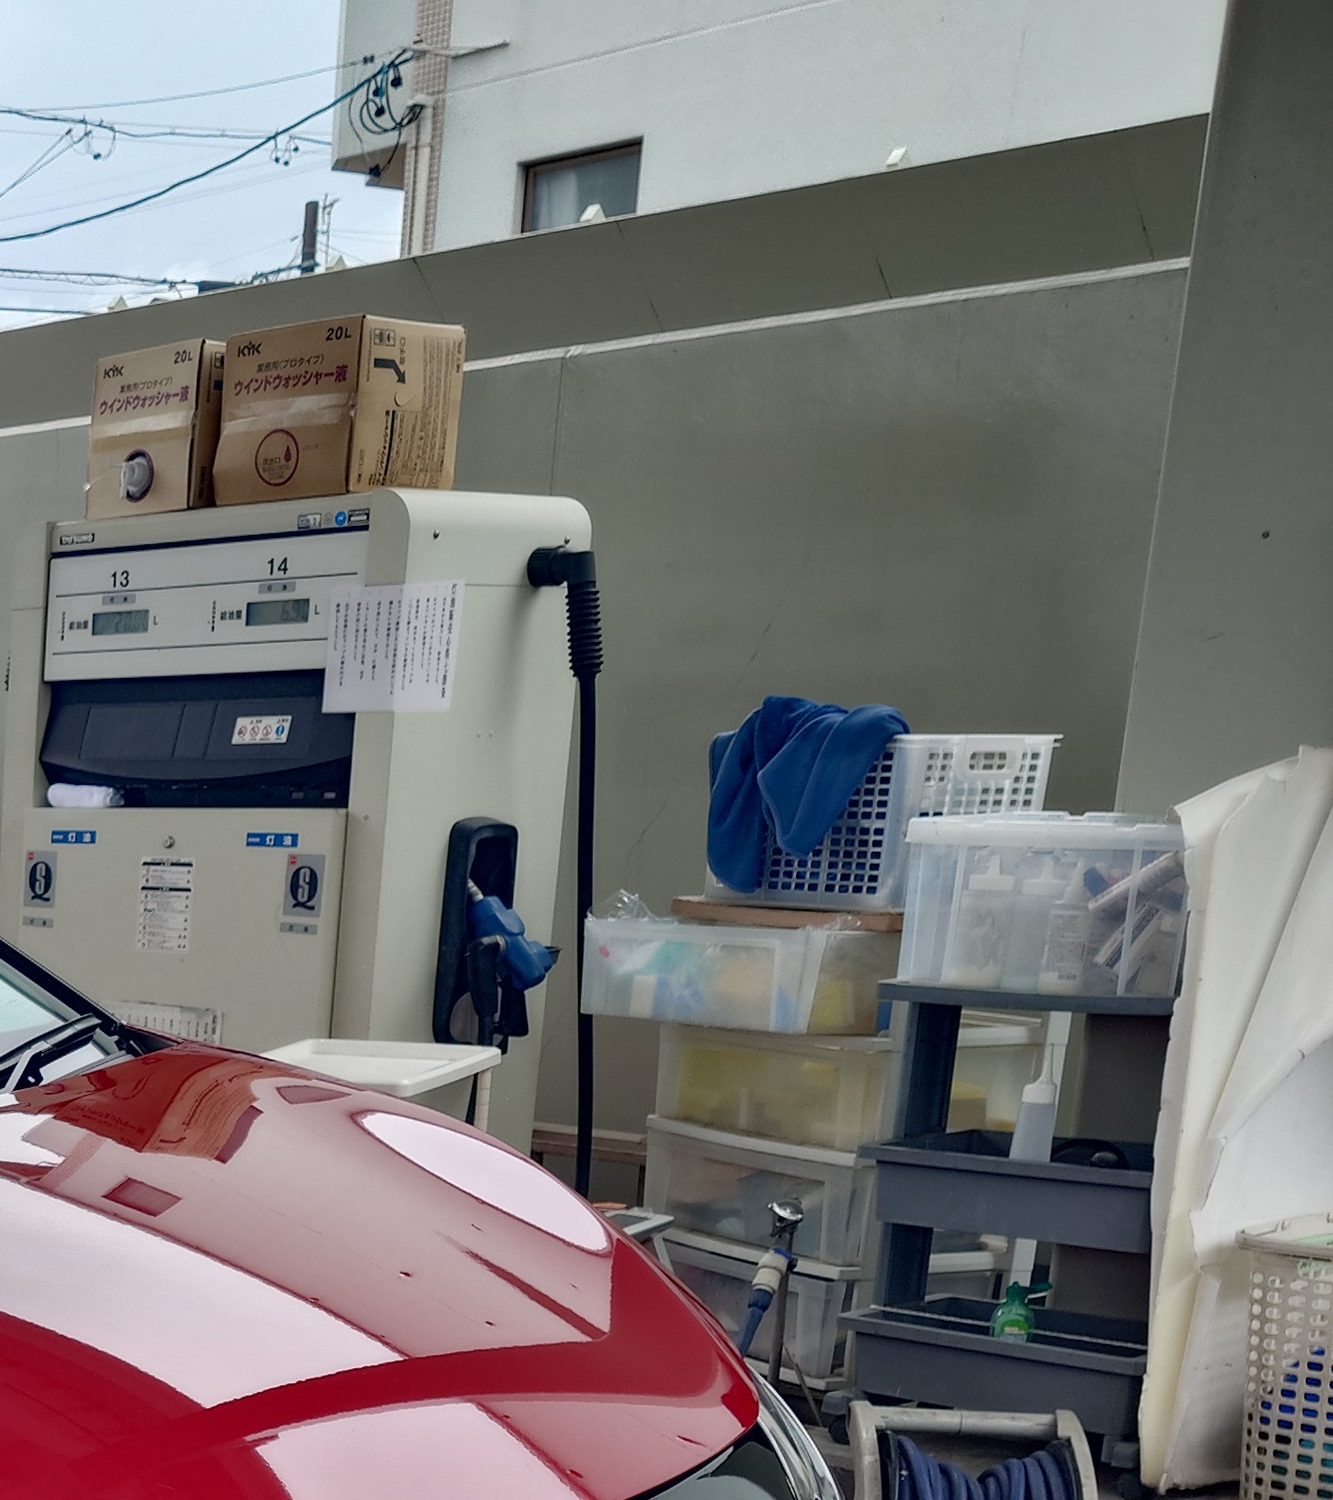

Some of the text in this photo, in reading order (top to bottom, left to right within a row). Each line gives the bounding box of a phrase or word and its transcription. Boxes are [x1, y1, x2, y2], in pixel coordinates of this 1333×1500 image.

[326, 326, 352, 341] 20L
[173, 350, 193, 365] 20L
[234, 364, 348, 396] ウインドウォッシャー液
[99, 385, 190, 416] ウインドウォッシャー液
[267, 556, 289, 576] 14
[110, 570, 130, 588] 13
